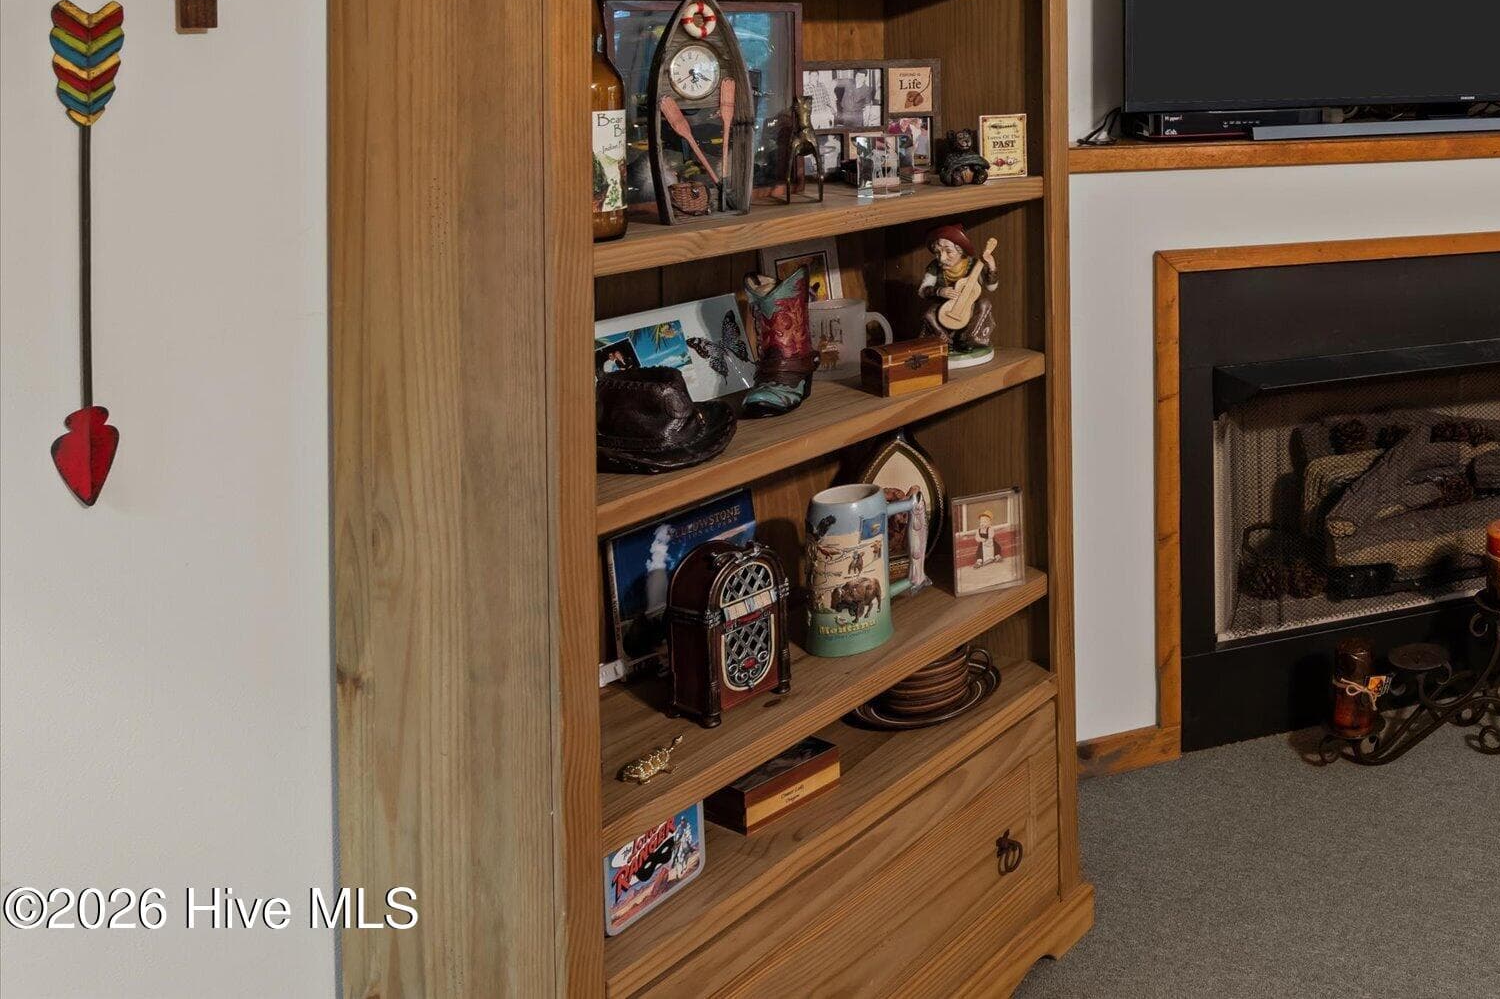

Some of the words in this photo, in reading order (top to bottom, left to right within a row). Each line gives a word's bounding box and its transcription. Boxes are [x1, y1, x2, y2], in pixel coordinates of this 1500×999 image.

[898, 78, 922, 90] Life
[596, 112, 624, 127] Bear
[992, 139, 1016, 149] PAST
[611, 817, 676, 904] RANGER
